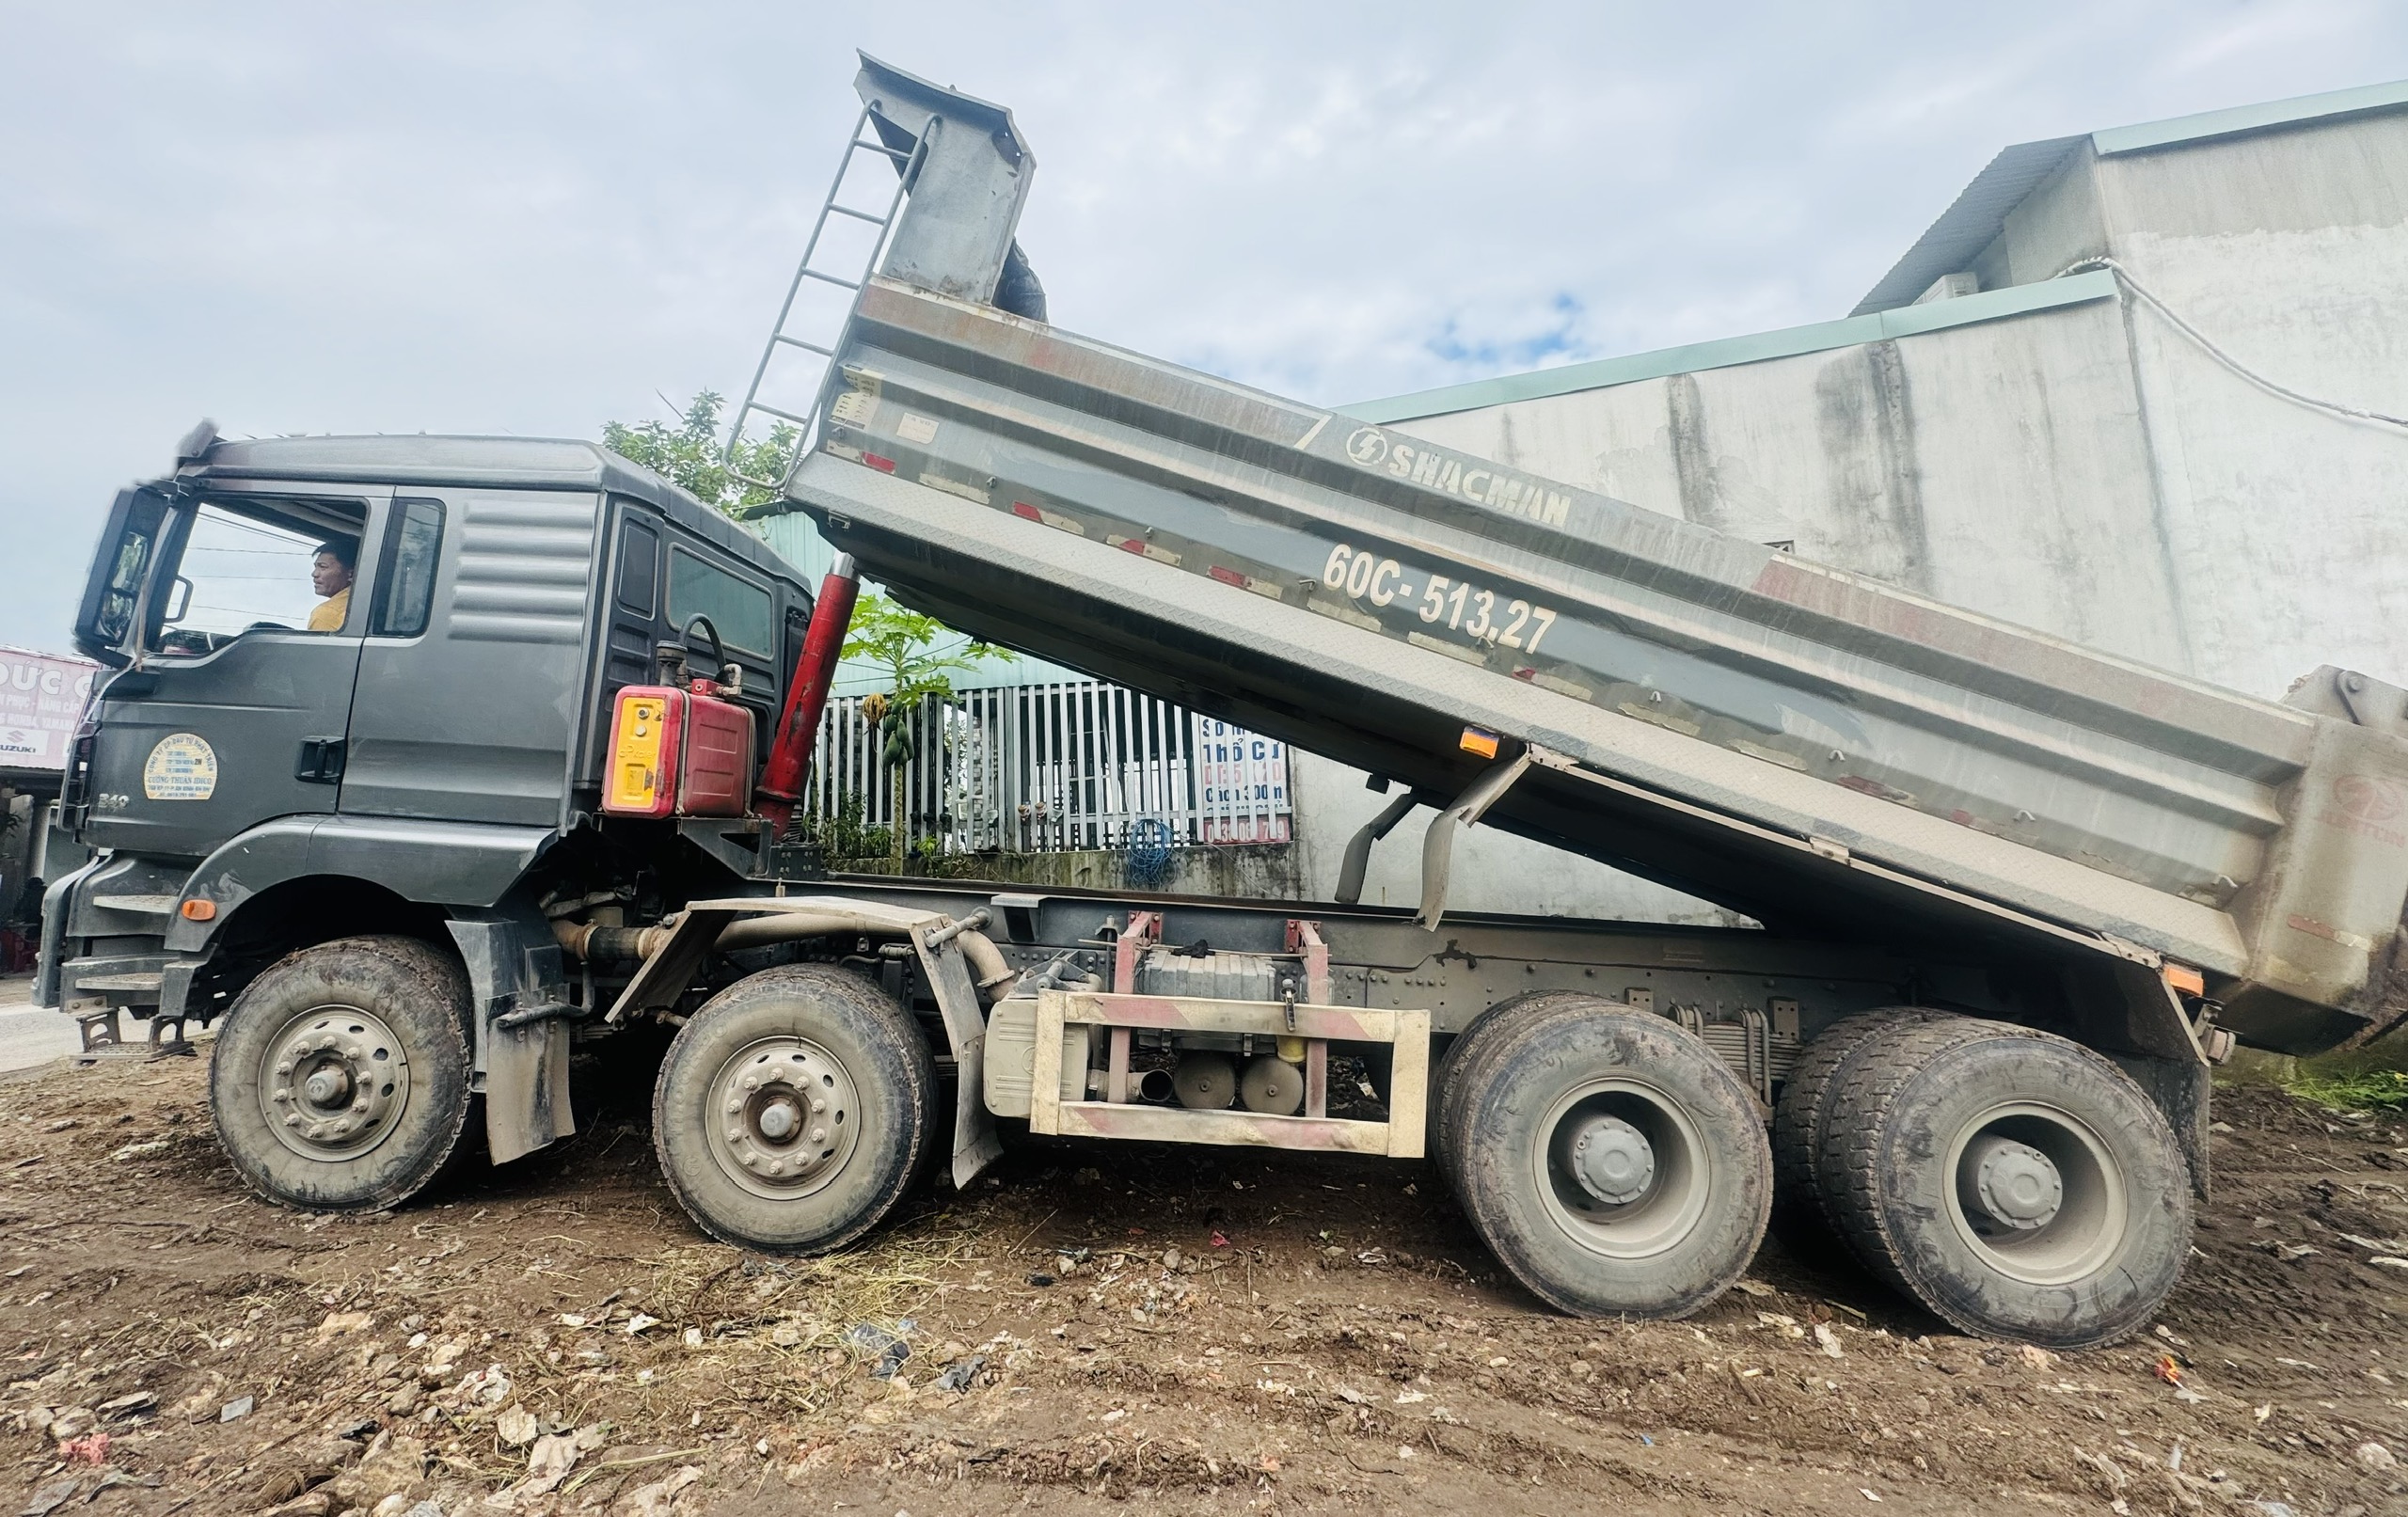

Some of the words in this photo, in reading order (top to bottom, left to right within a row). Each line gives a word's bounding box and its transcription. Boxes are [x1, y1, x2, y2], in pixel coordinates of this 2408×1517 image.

[1388, 444, 1572, 528] SHACMAN
[1418, 574, 1557, 655] 513.27
[0, 743, 36, 753] UZUKI
[1262, 820, 1285, 840] 79
